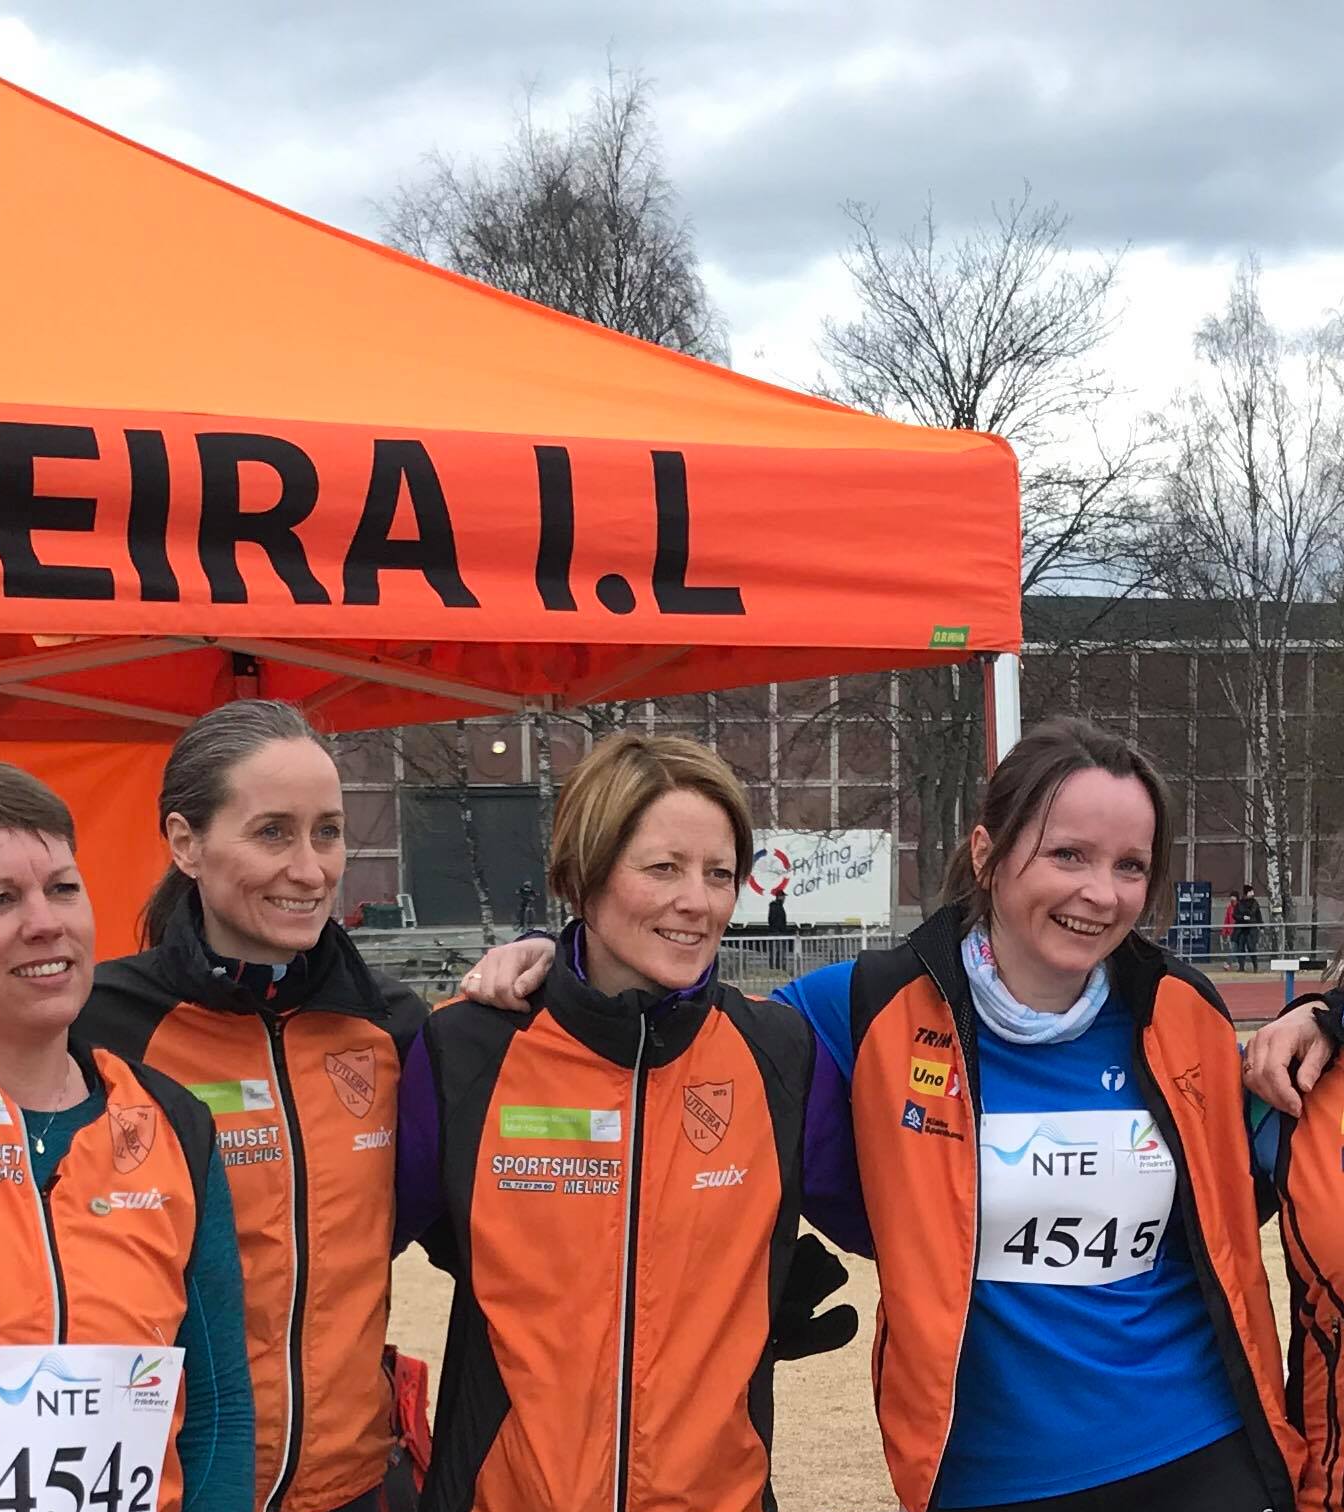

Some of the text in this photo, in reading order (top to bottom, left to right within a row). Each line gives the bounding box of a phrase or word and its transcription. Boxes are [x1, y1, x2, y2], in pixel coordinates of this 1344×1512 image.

[533, 445, 746, 615] I.L
[792, 845, 852, 876] Flytting
[792, 858, 874, 897] dør til dør
[913, 1066, 945, 1087] Uno
[686, 1095, 722, 1132] UTLEIRA
[216, 1126, 280, 1149] HUSET
[224, 1147, 283, 1166] MELHUS
[492, 1155, 621, 1177] SPORTSHUSET
[1032, 1151, 1098, 1177] NTE
[563, 1180, 620, 1195] MELHUS
[37, 1388, 102, 1417] NTE
